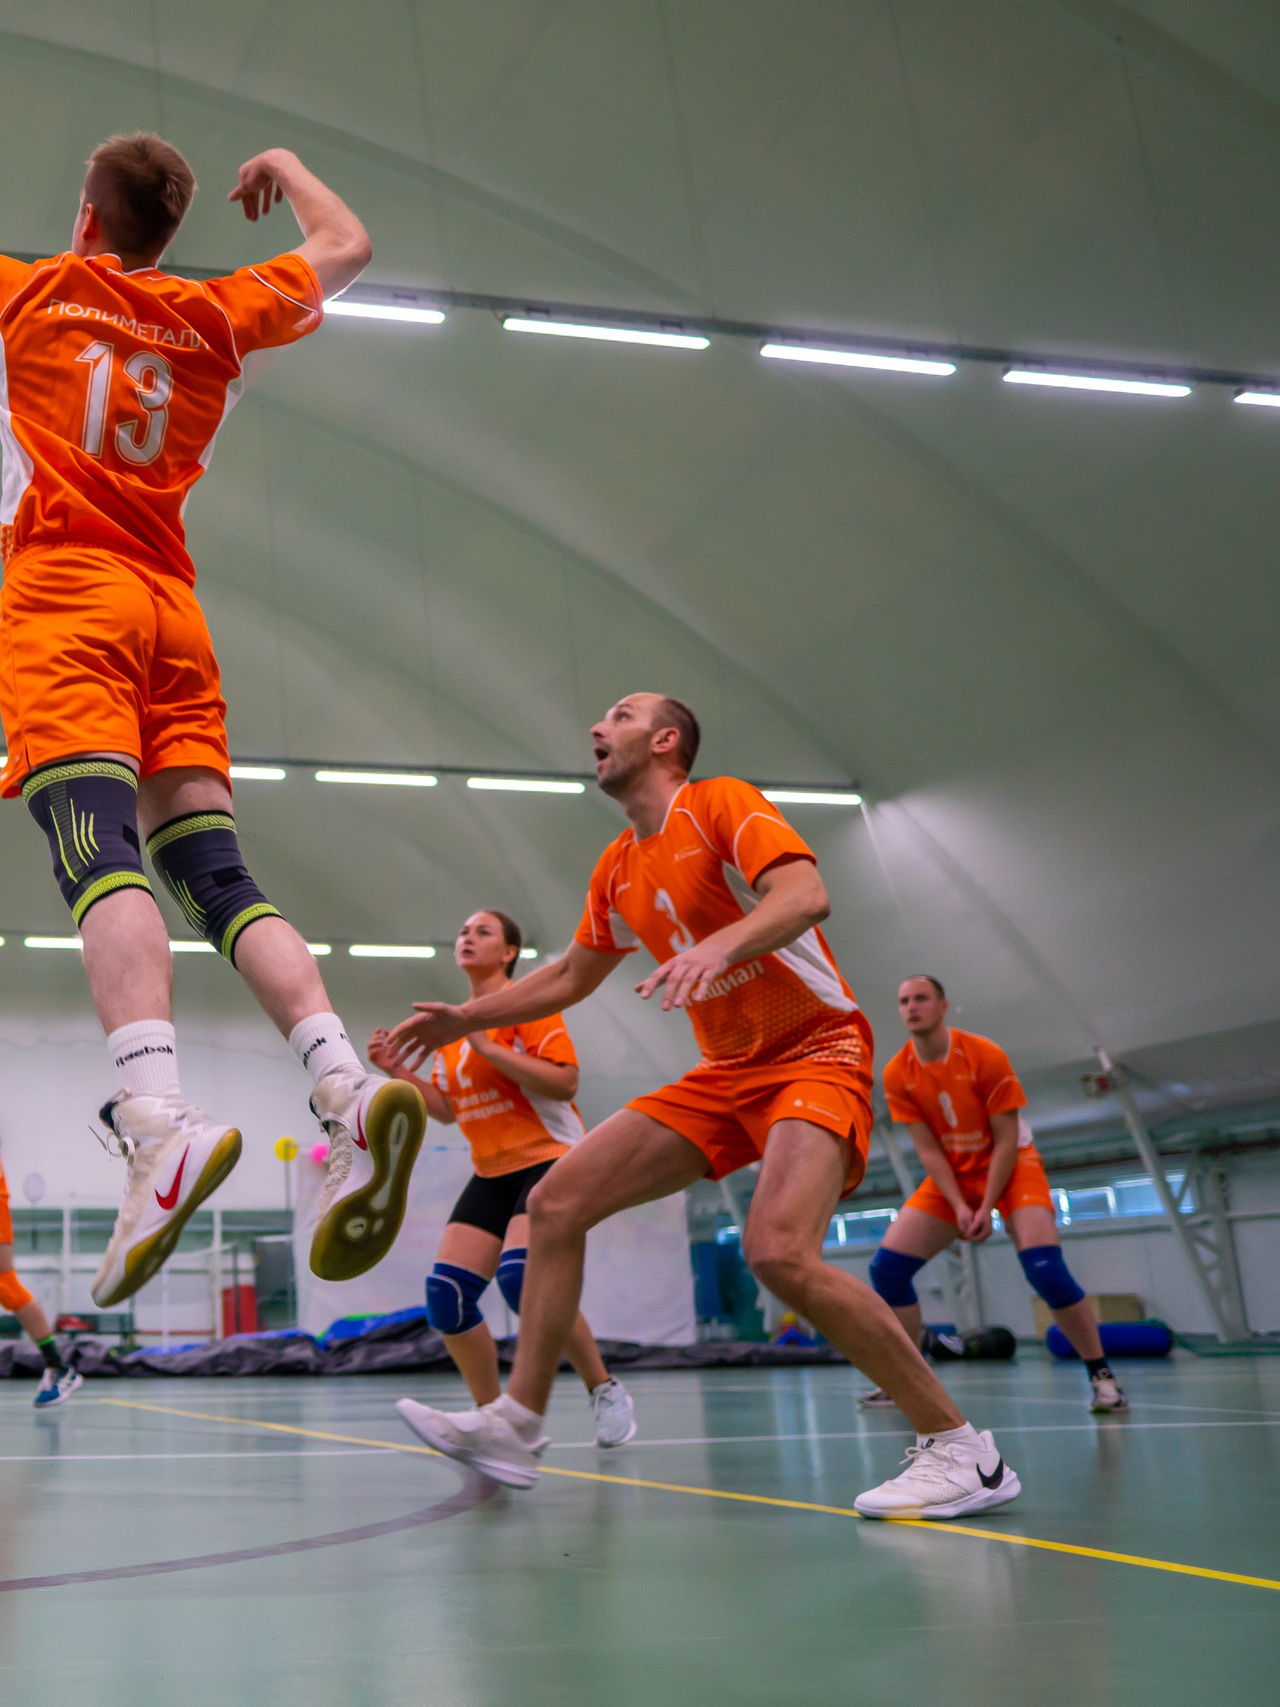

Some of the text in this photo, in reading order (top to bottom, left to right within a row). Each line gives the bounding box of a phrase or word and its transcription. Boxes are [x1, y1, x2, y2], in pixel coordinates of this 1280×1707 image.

[74, 339, 173, 467] 13
[654, 887, 695, 954] 3
[455, 1040, 473, 1089] 2
